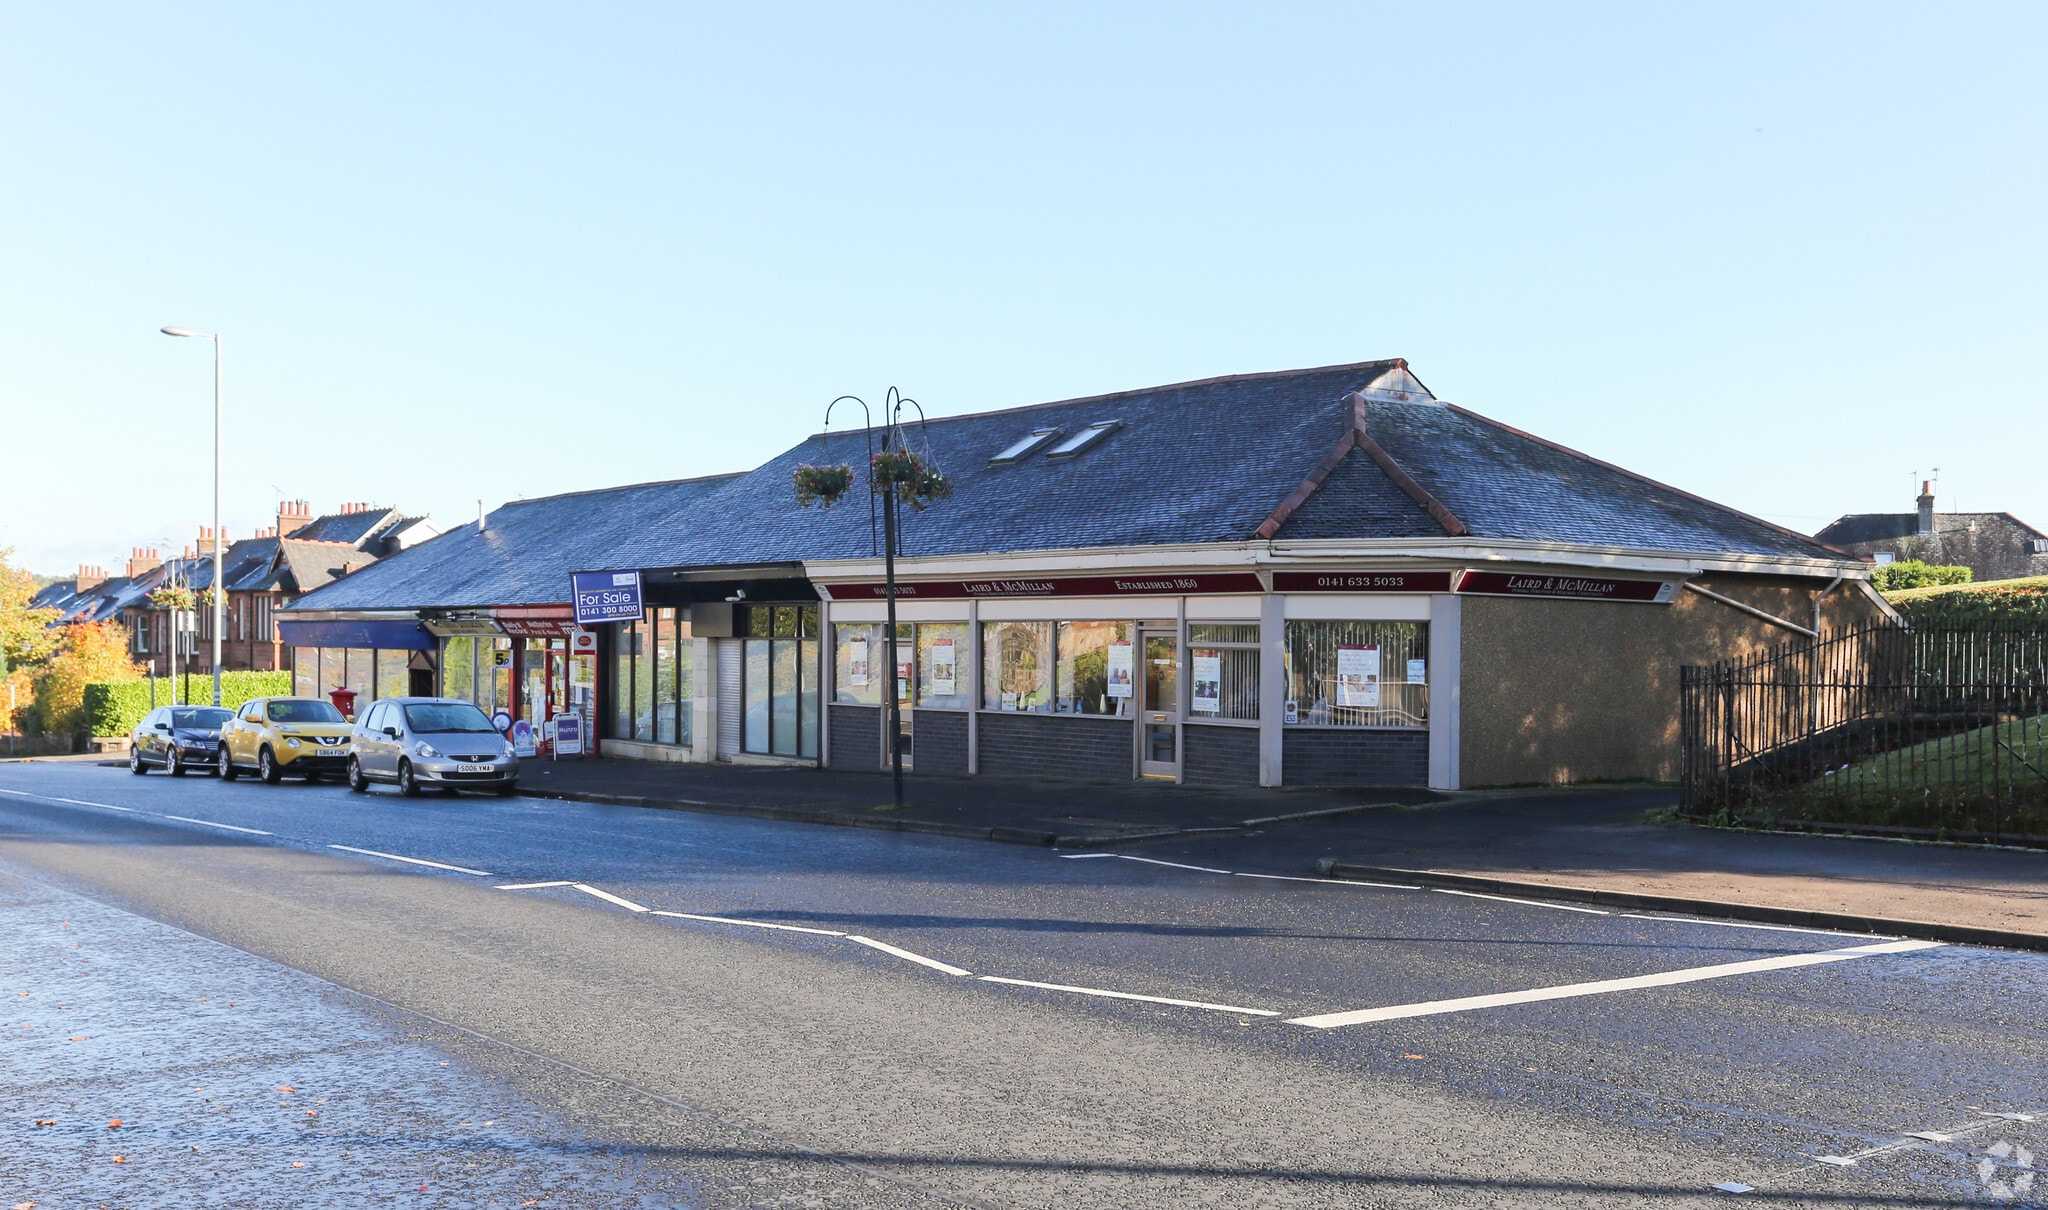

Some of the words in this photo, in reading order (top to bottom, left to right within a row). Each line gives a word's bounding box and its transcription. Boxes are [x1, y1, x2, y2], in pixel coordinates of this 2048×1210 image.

[991, 581, 1001, 592] &
[1173, 579, 1198, 589] 1860
[1317, 577, 1343, 586] 0141
[1348, 577, 1370, 586] 633
[1374, 577, 1404, 586] 5033
[1543, 577, 1554, 590] &
[580, 594, 600, 606] For
[603, 591, 631, 604] Sale
[581, 607, 600, 616] 0141
[602, 606, 617, 614] 300
[618, 605, 638, 613] 8000
